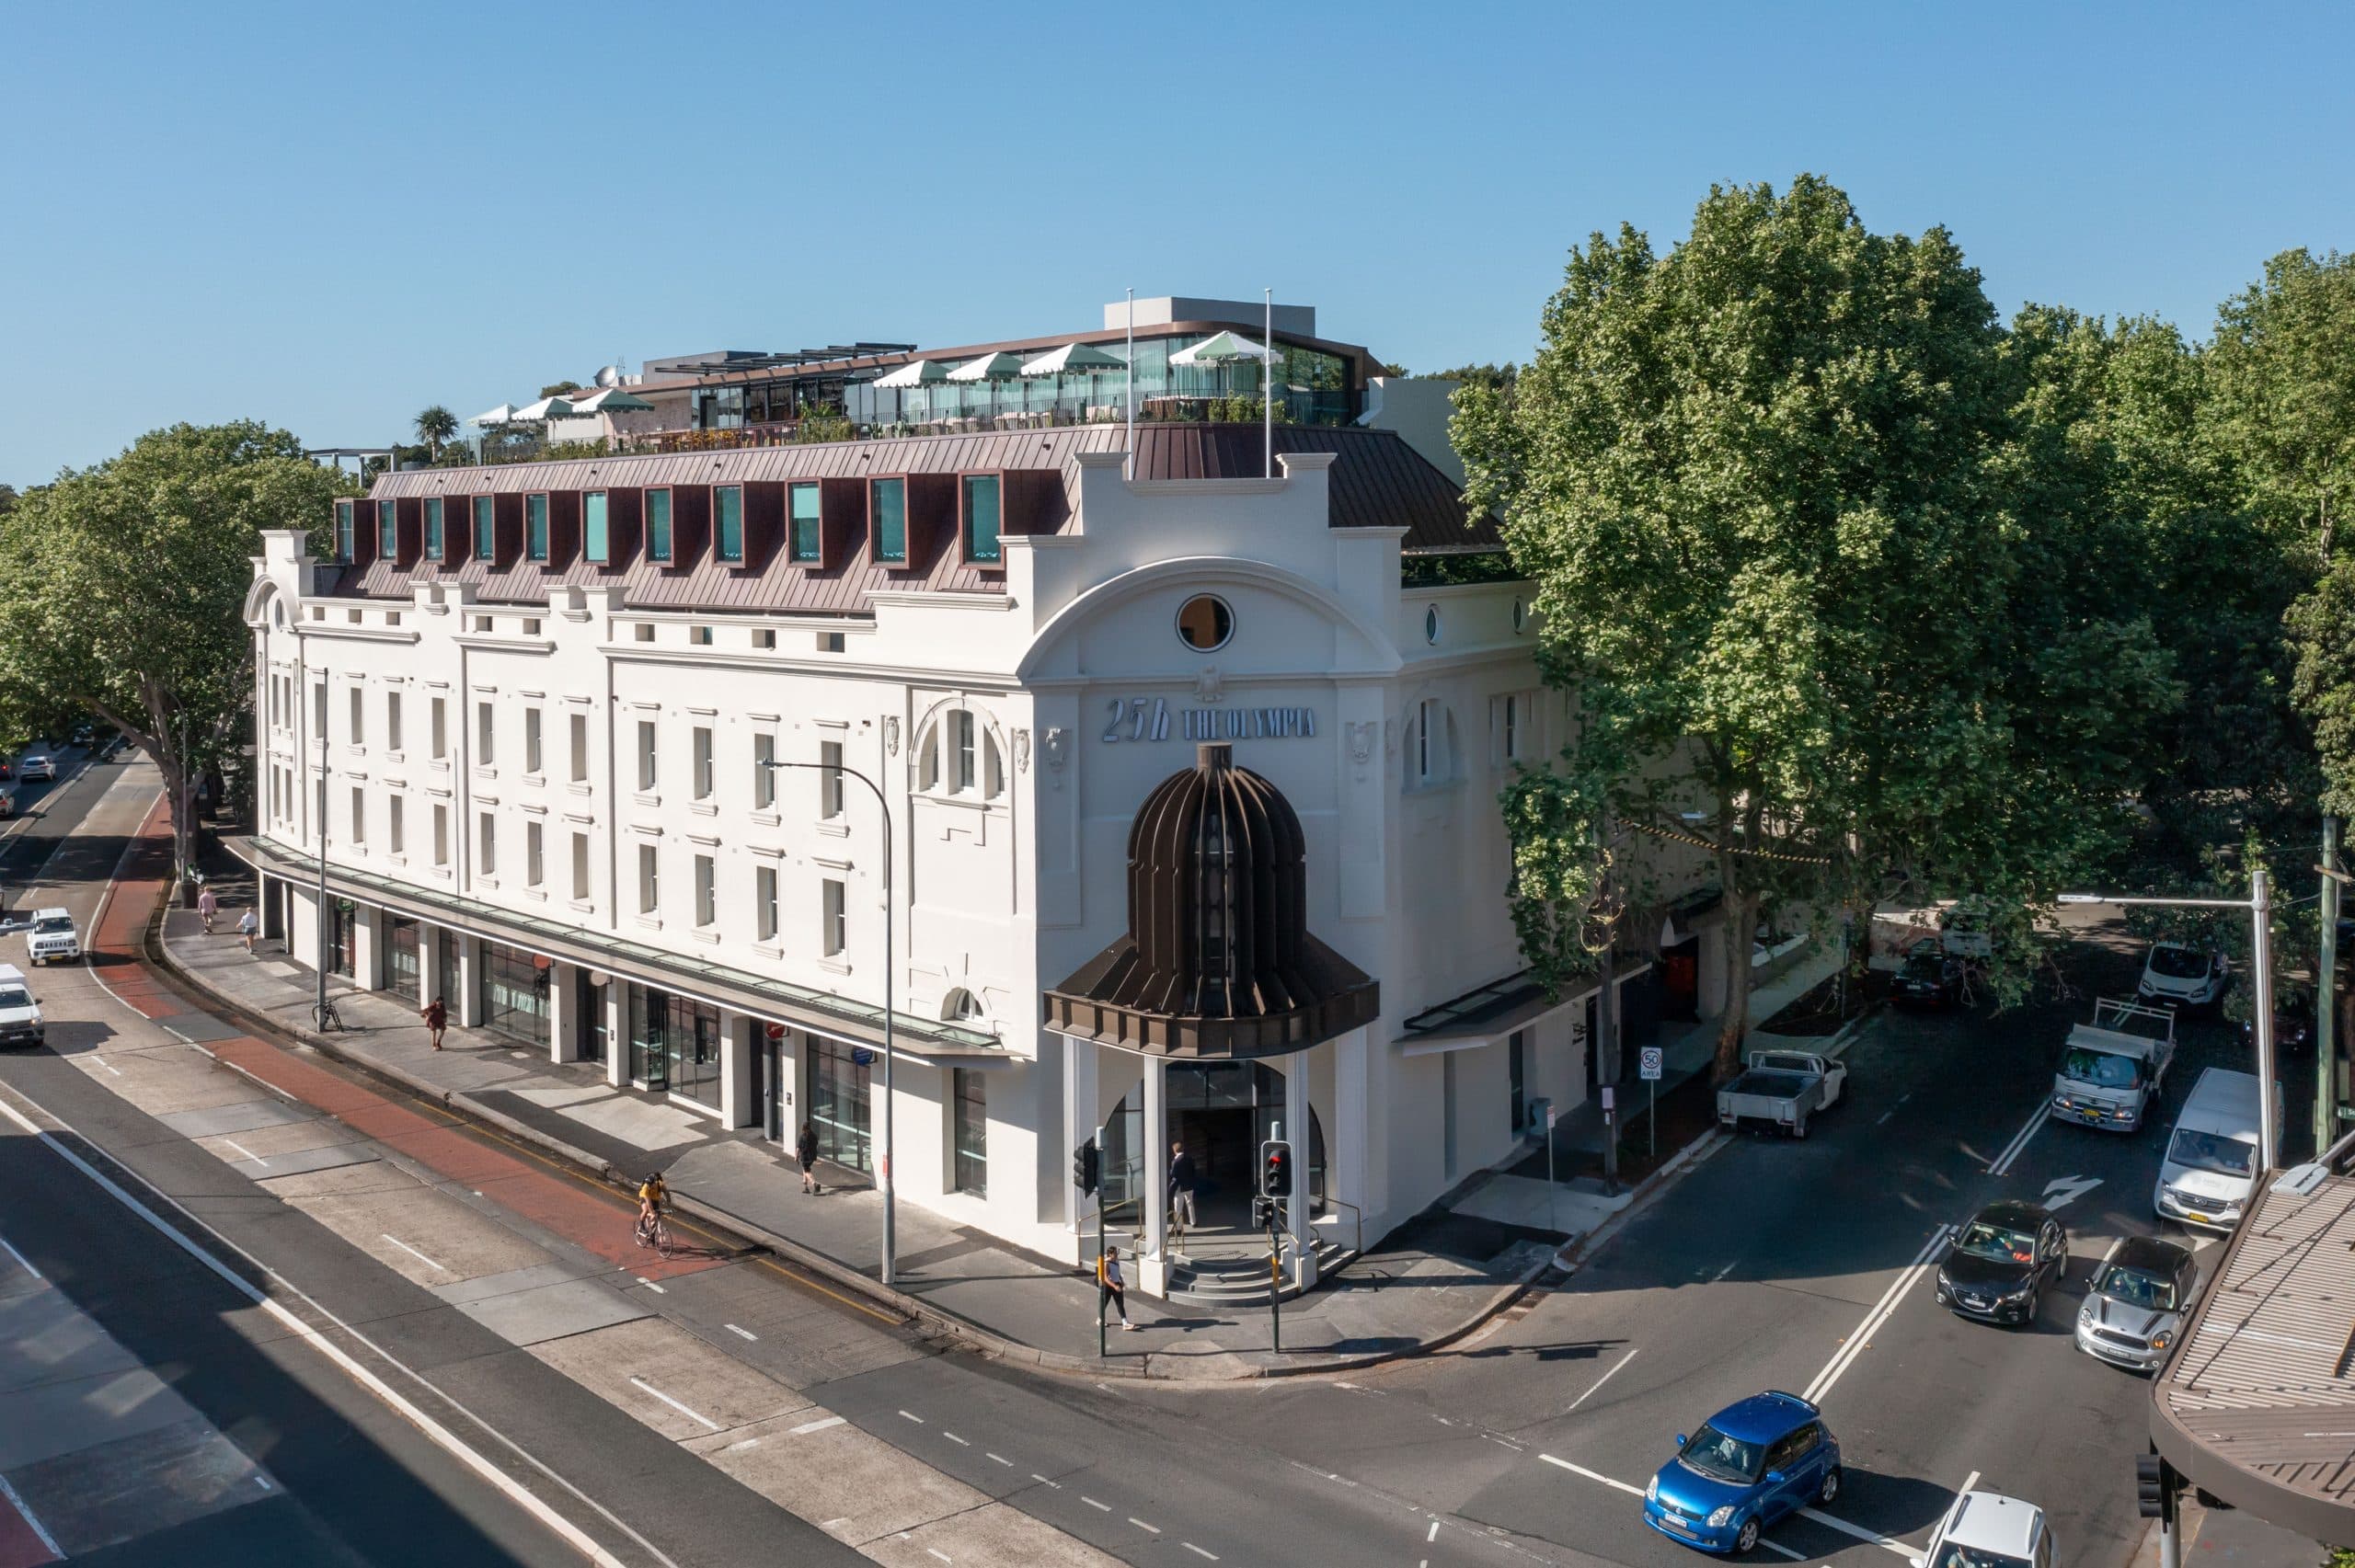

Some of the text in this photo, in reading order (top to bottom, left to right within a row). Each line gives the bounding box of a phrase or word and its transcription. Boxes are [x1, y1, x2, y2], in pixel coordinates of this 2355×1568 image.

[1102, 697, 1315, 743] 25h THE OLYMPIA
[1645, 1055, 1659, 1065] 50
